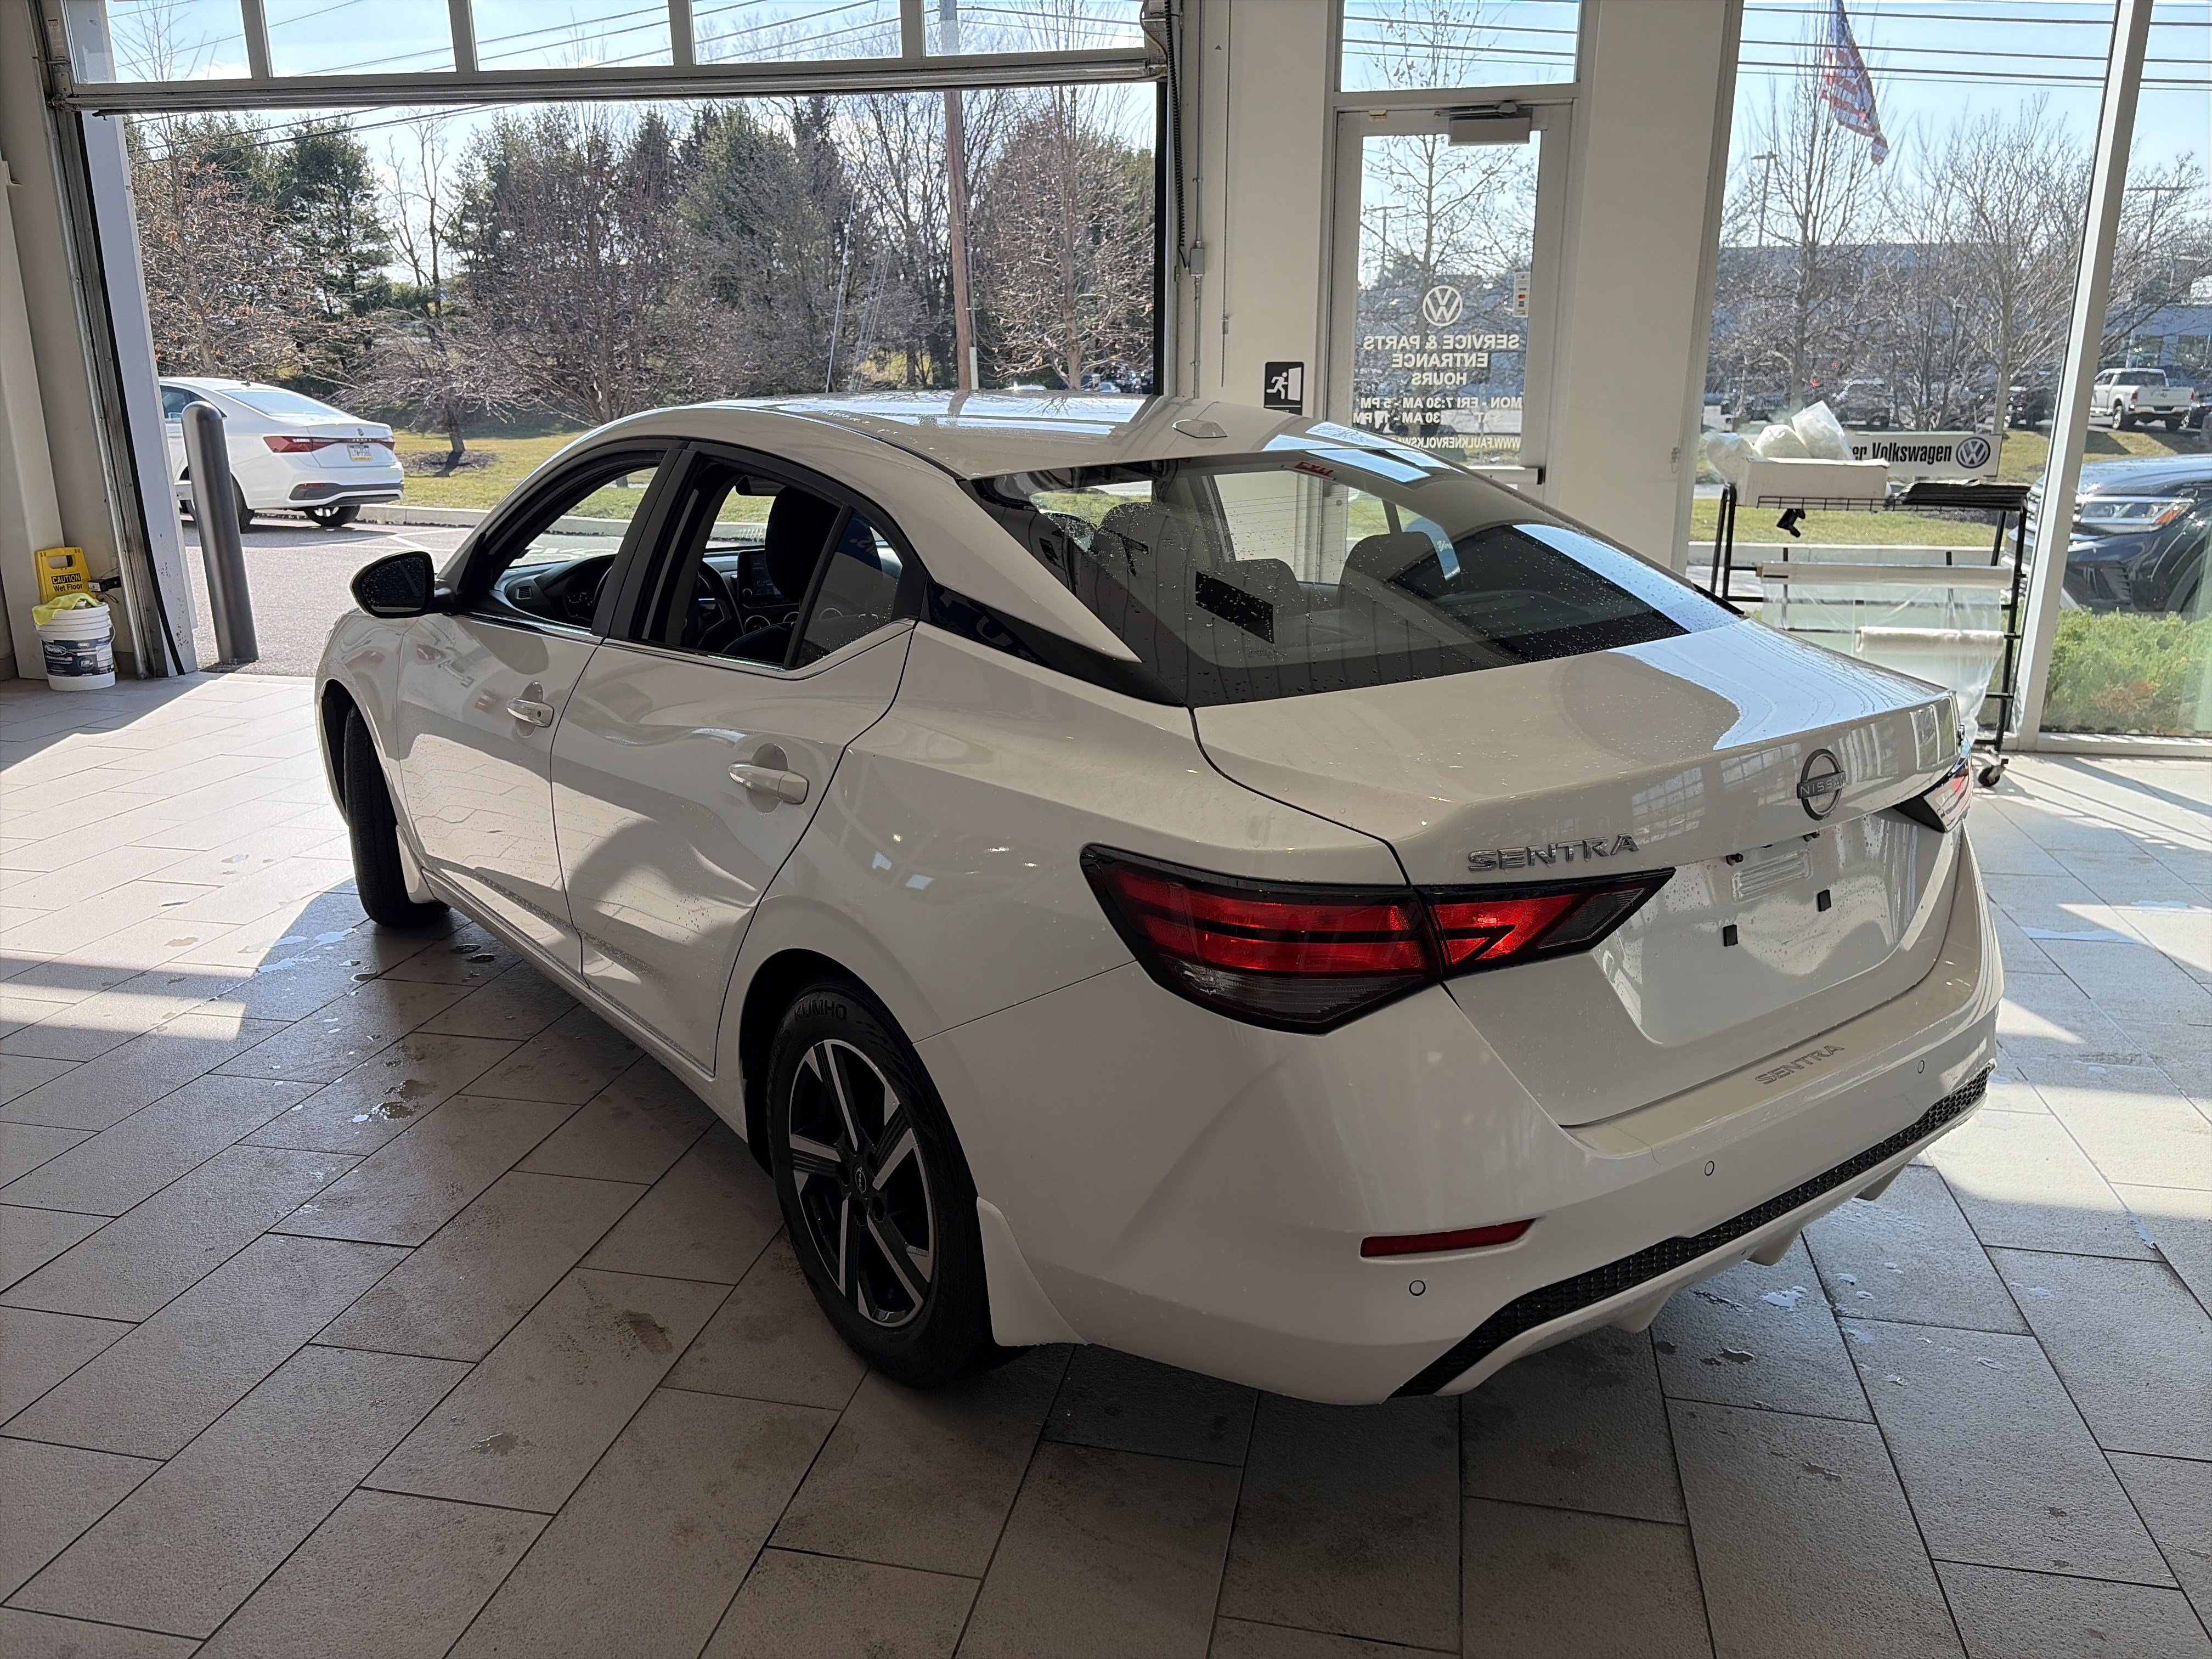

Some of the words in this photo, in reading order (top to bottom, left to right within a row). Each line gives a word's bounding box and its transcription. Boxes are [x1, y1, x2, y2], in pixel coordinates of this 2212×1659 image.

[1872, 442, 1953, 465] Volkswagen
[52, 574, 81, 584] CAUTION
[1799, 772, 1846, 795] NISSAN
[1468, 833, 1639, 873] SENTRA
[794, 999, 847, 1023] KUMHO
[1754, 1045, 1845, 1085] SENTRA
